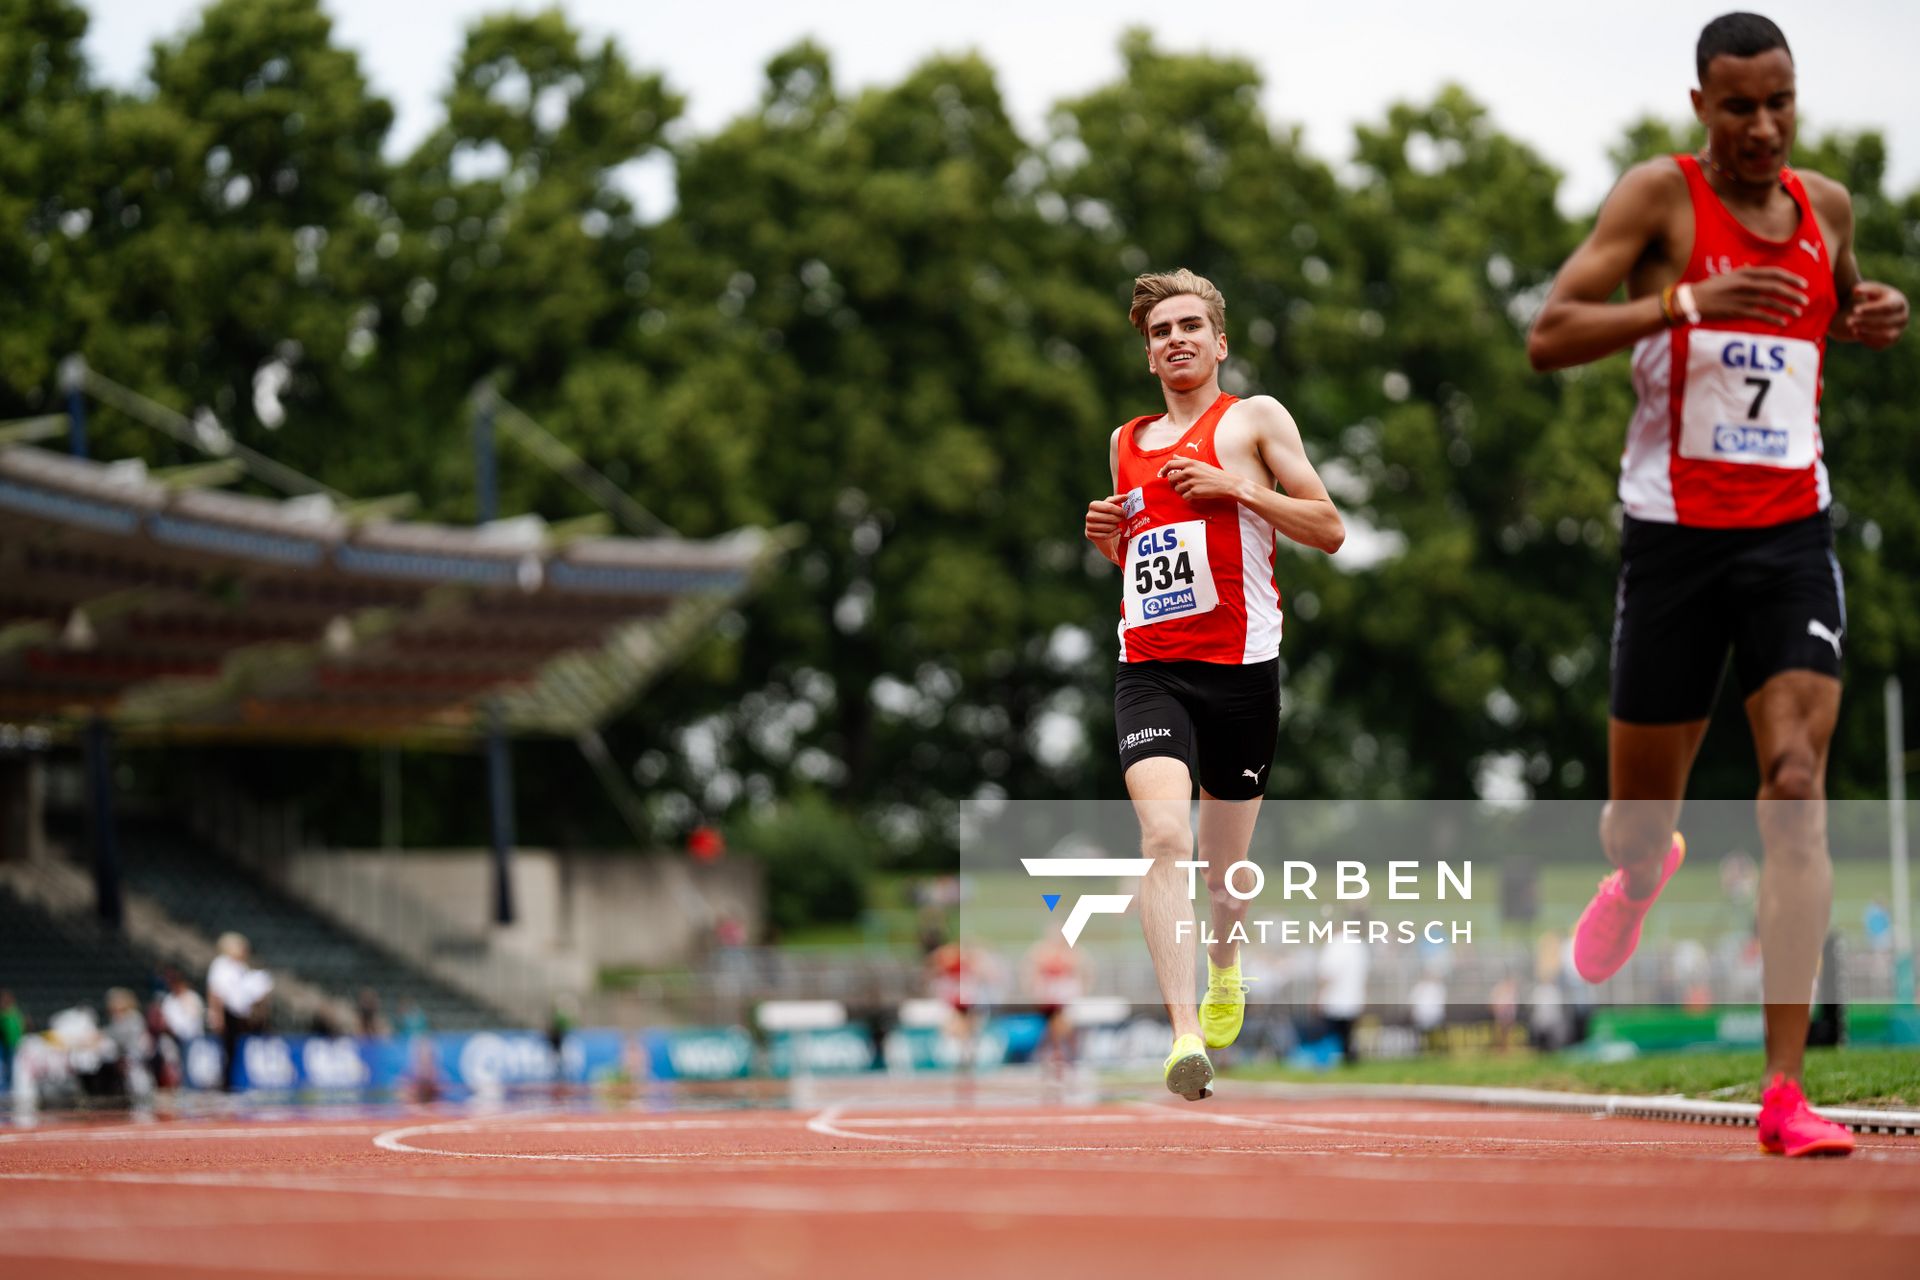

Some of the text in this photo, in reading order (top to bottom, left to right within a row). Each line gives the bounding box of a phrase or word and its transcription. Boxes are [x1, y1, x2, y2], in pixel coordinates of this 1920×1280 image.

[1744, 376, 1771, 419] 7
[1135, 551, 1194, 595] 534
[1162, 592, 1193, 608] PLAN
[1126, 727, 1172, 745] Brillux
